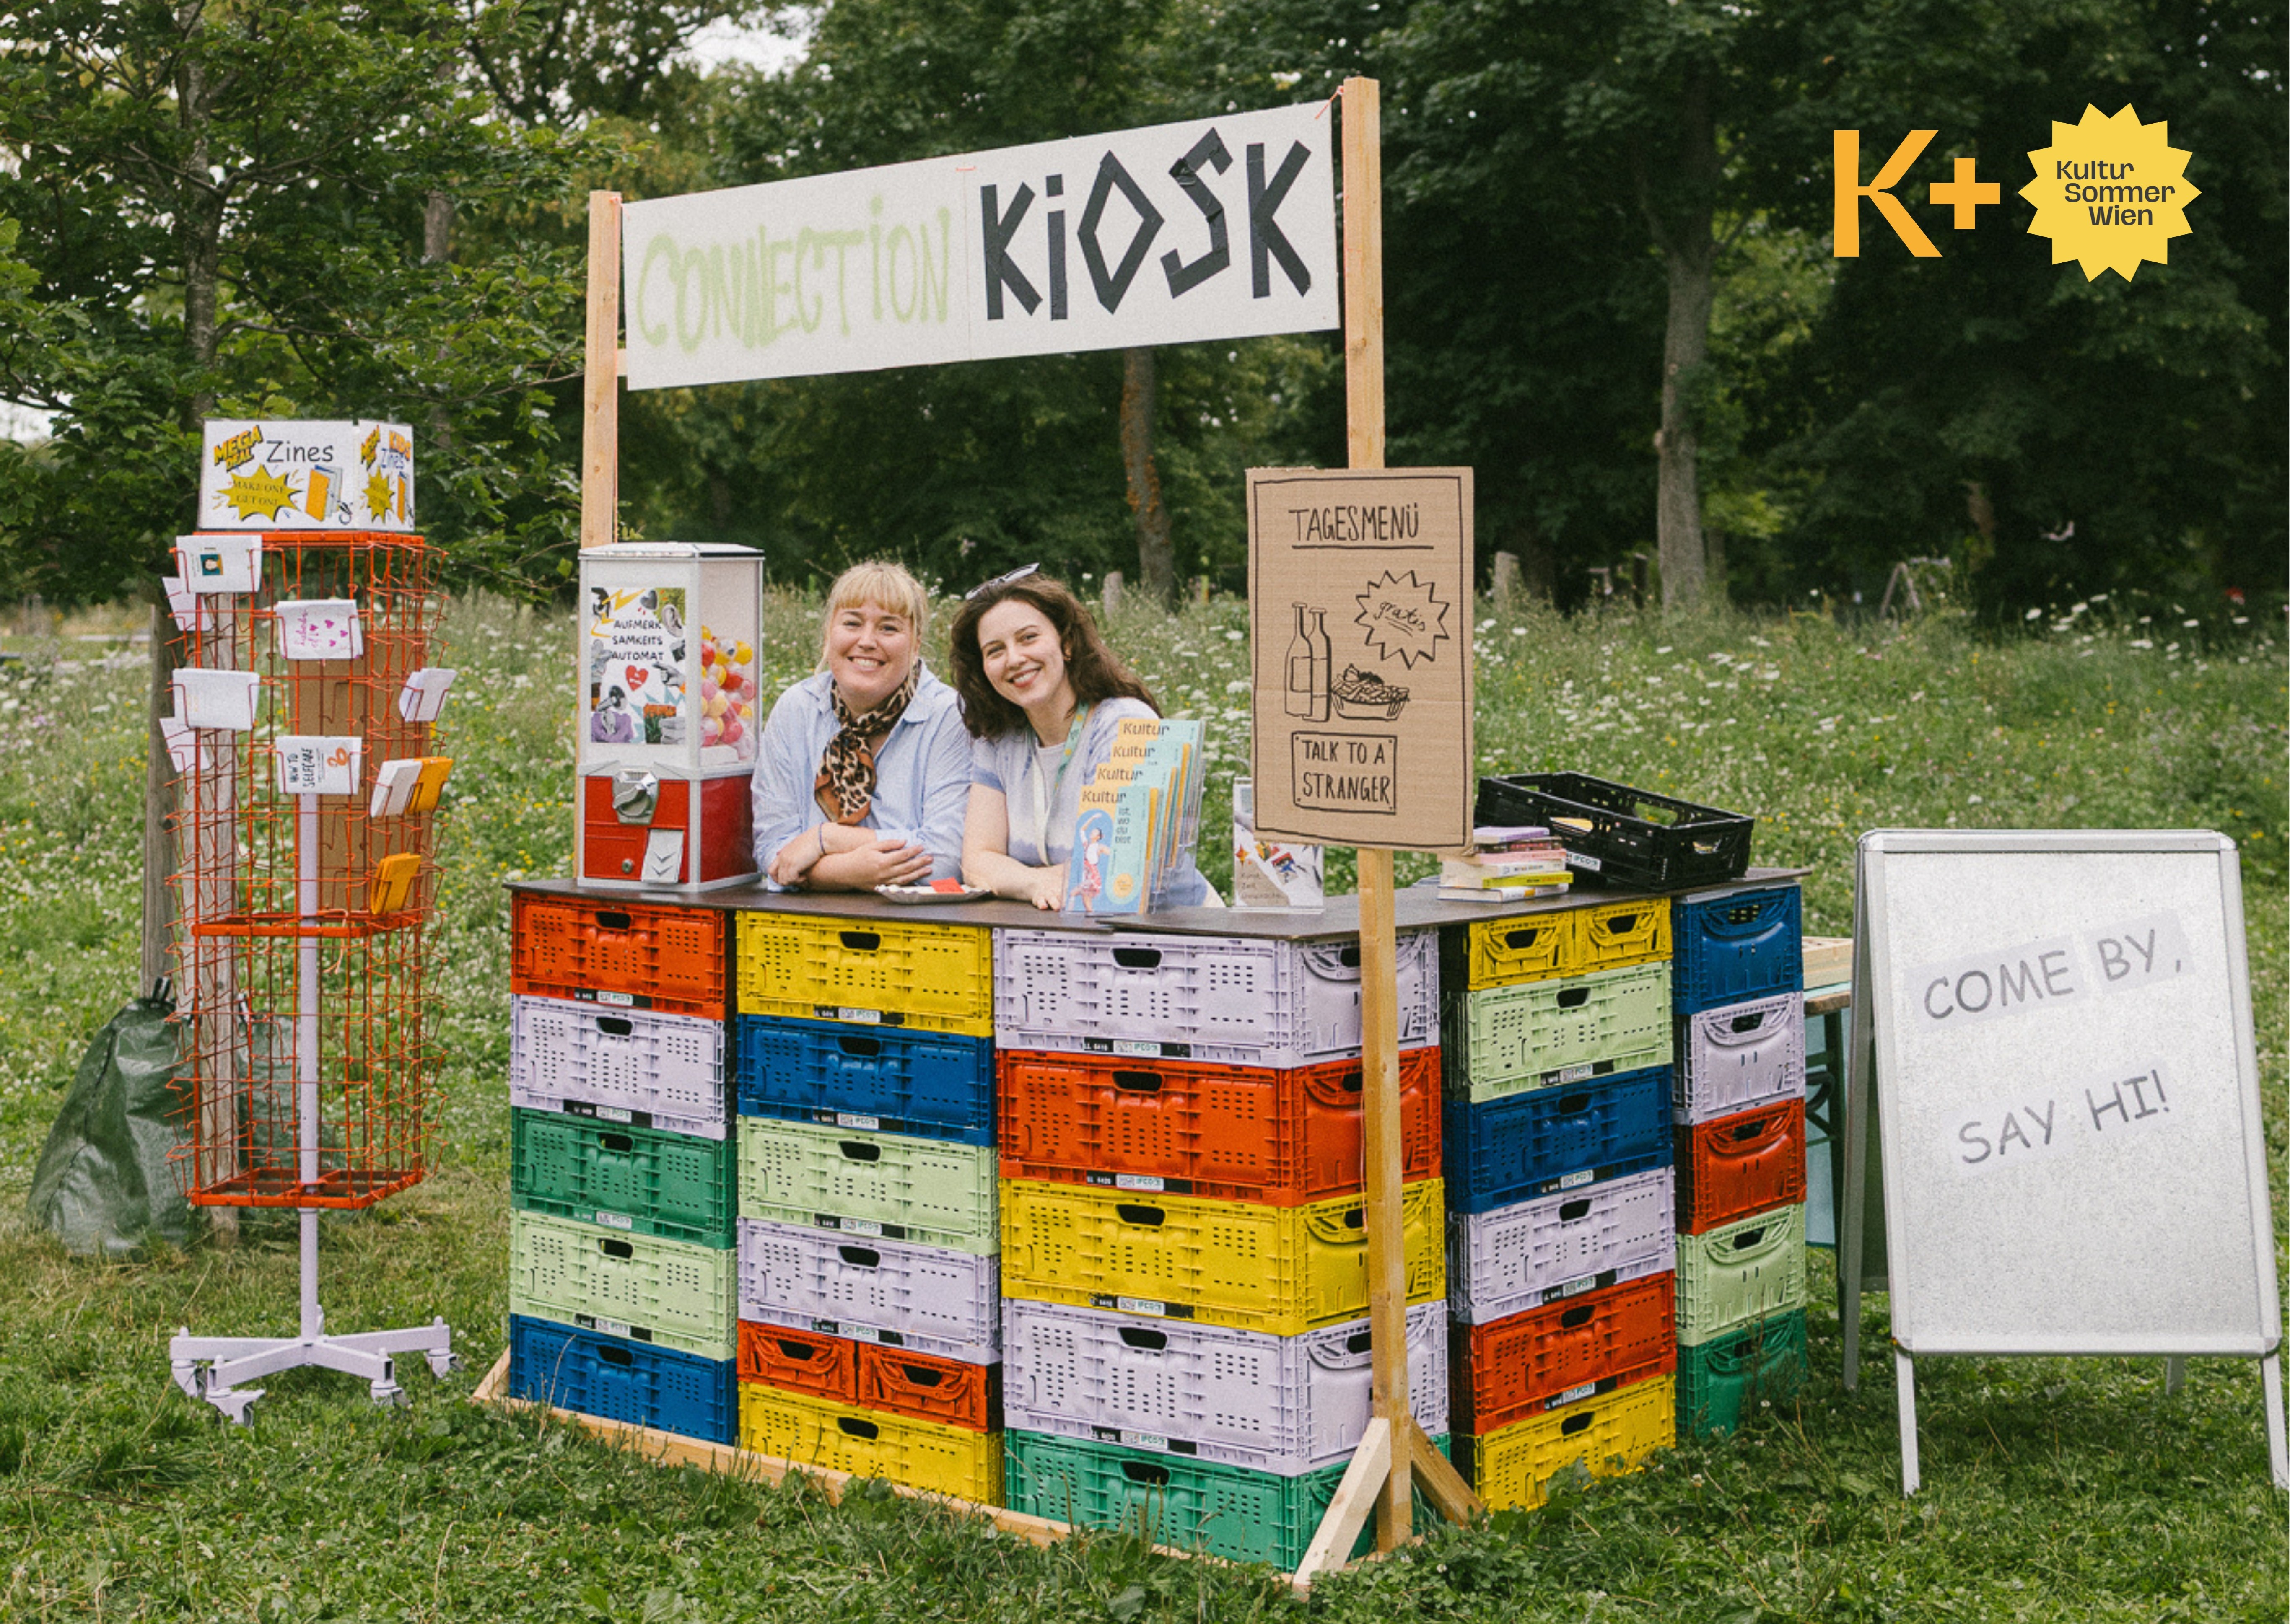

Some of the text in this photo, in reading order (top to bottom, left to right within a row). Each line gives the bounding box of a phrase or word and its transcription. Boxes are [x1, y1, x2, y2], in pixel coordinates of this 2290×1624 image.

[636, 197, 952, 355] CONNECTION
[214, 424, 264, 466] MEGA
[266, 440, 334, 463] Zines
[233, 479, 285, 494] MAKE ONE
[236, 495, 279, 506] GET ONE
[1288, 503, 1419, 541] TAGESMENÜ
[613, 619, 662, 629] AUFMERK
[612, 636, 663, 645] SAMKEITS
[612, 651, 664, 661] AUTOMAT
[1123, 723, 1170, 735] Kultur
[1113, 746, 1155, 757] Kultur
[1302, 740, 1385, 764] TALK TO A
[1098, 768, 1143, 781] Kultur
[1303, 772, 1391, 804] STRANGER
[1082, 790, 1126, 803] Kultur
[1924, 929, 2181, 1019] COME BY,
[1958, 1069, 2170, 1164] SAY HI!
